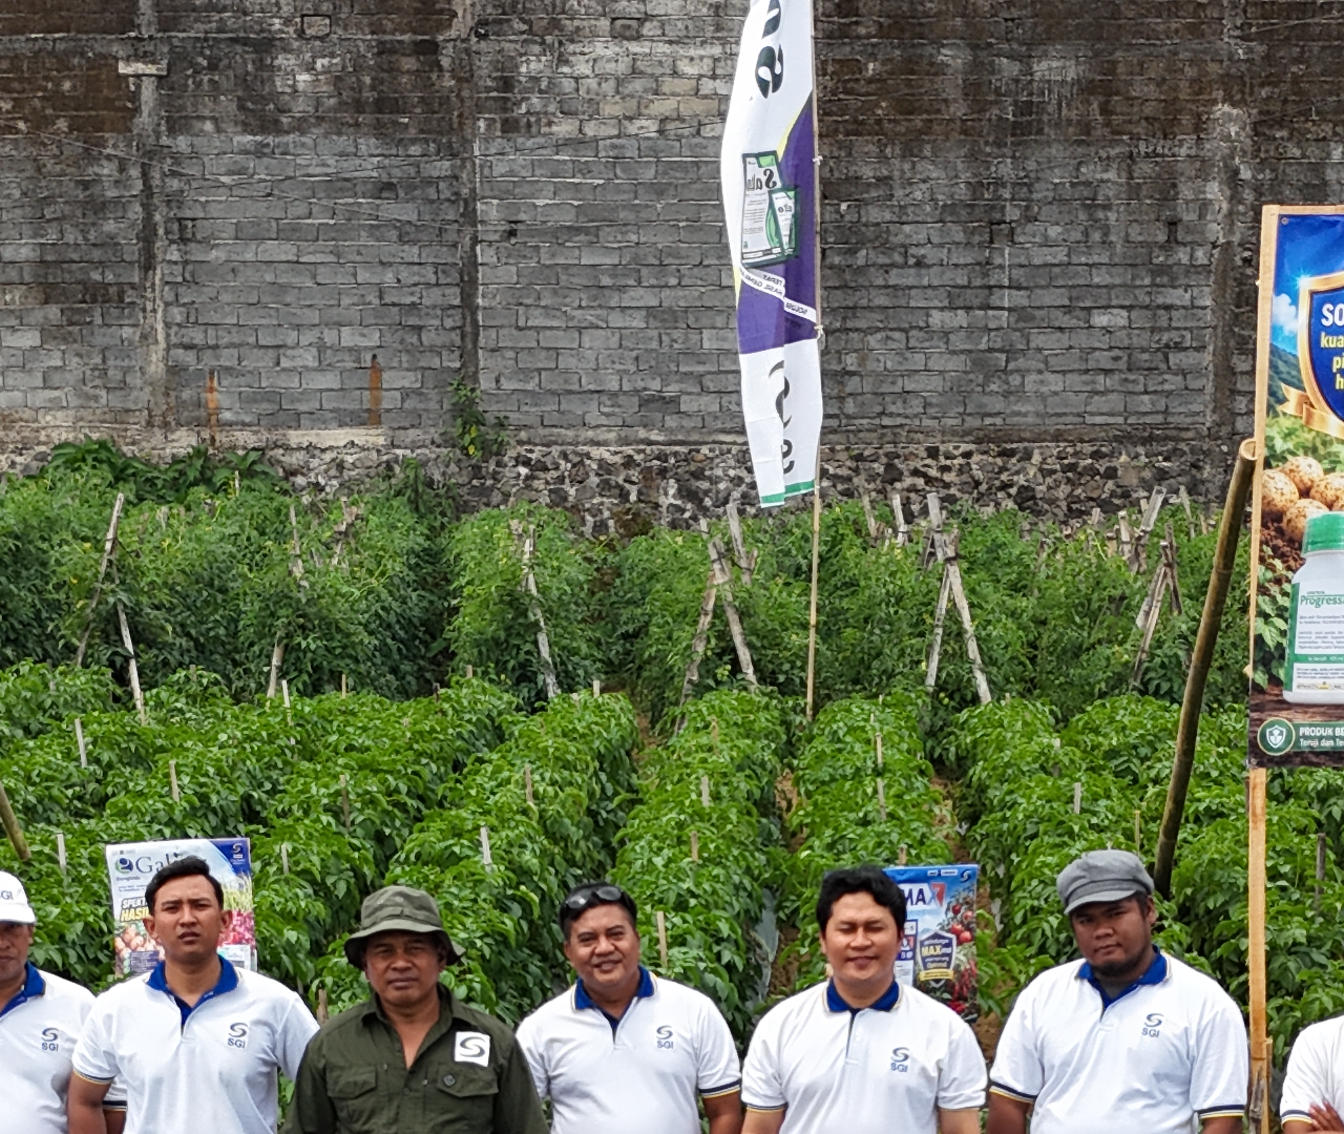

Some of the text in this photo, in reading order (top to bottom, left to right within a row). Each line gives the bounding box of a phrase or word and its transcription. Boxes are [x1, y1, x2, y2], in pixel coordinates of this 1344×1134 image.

[1299, 727, 1333, 737] PRODUK
[1141, 1027, 1160, 1038] SGI
[41, 1042, 59, 1052] SGI
[227, 1037, 246, 1049] SGI
